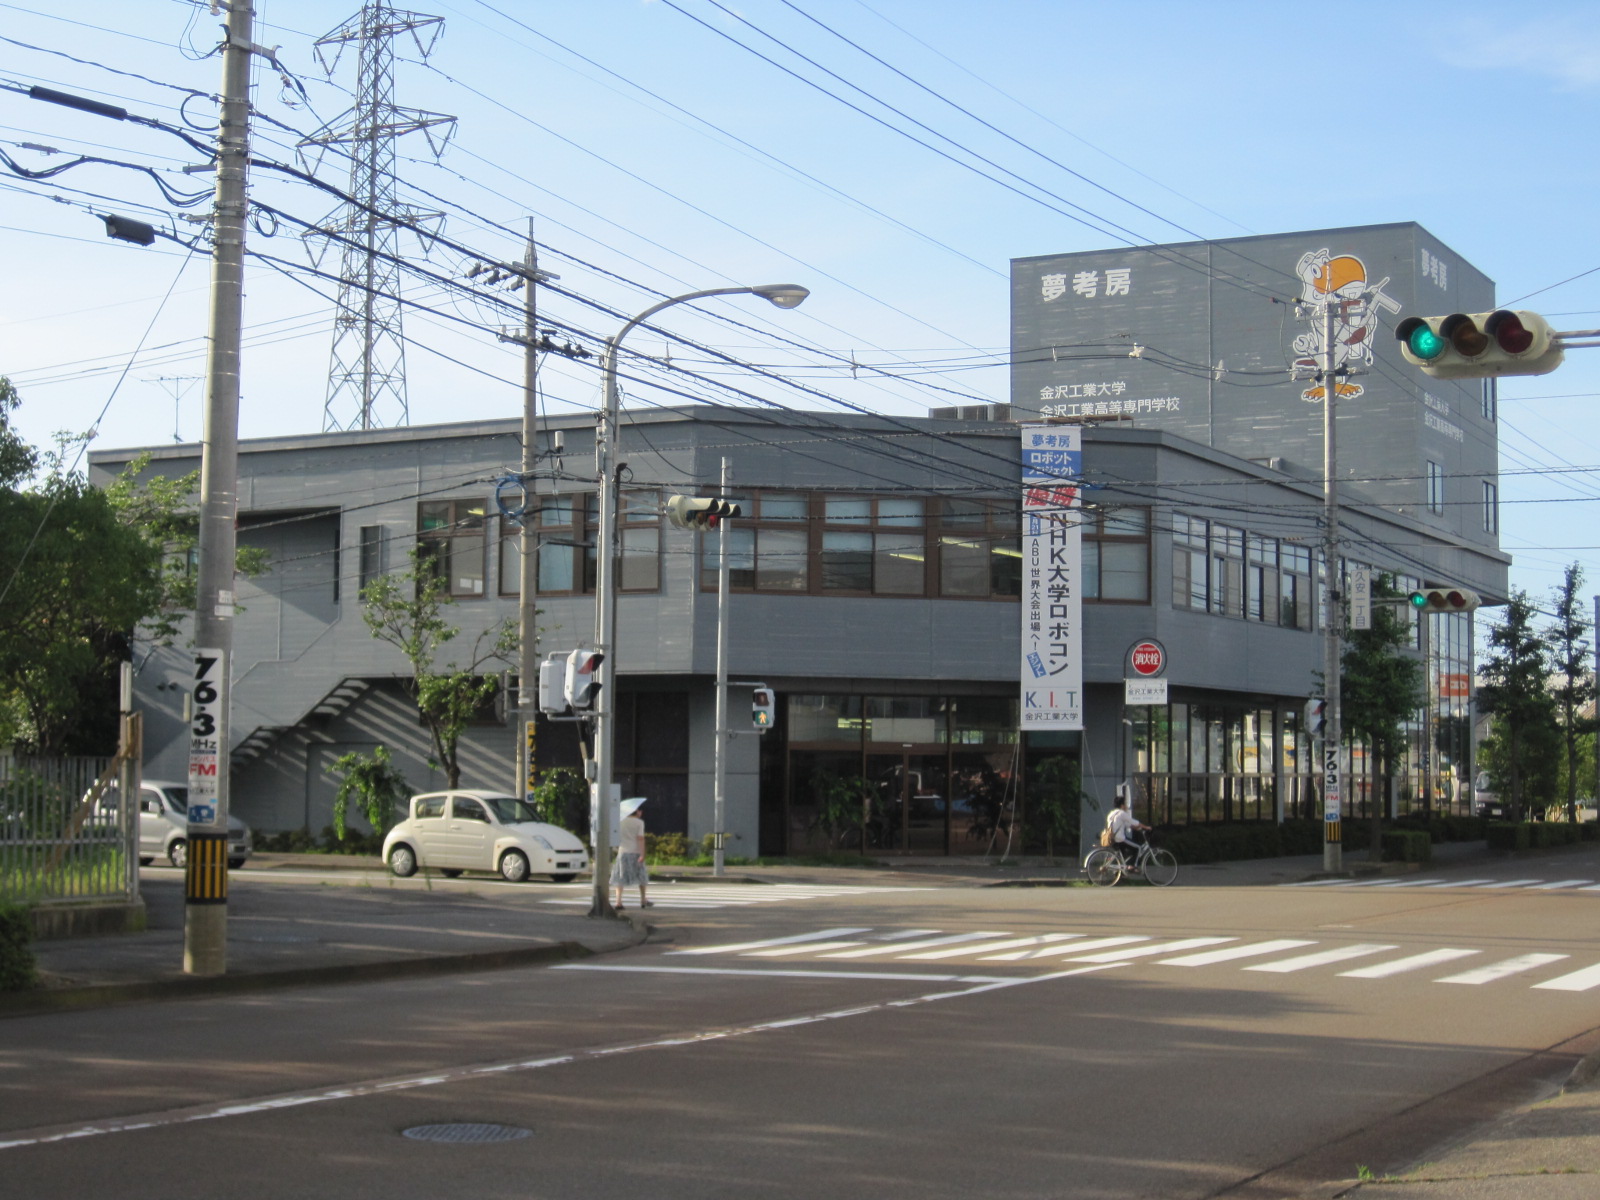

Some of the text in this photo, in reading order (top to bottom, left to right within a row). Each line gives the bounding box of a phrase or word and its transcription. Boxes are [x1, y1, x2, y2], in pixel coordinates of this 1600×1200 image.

[1041, 268, 1131, 301] 夢考房
[1039, 381, 1126, 400] 金沢工業大学
[1039, 396, 1180, 419] 金沢工業高等専門学校
[1031, 434, 1070, 448] 夢考房
[1031, 451, 1072, 465] ロボット
[1047, 512, 1070, 676] NHK大学ロボコン
[1355, 571, 1366, 627] 久安一丁目
[1135, 652, 1159, 665] 消火栓
[1025, 712, 1078, 721] 金沢工業大学
[190, 763, 216, 776] FM
